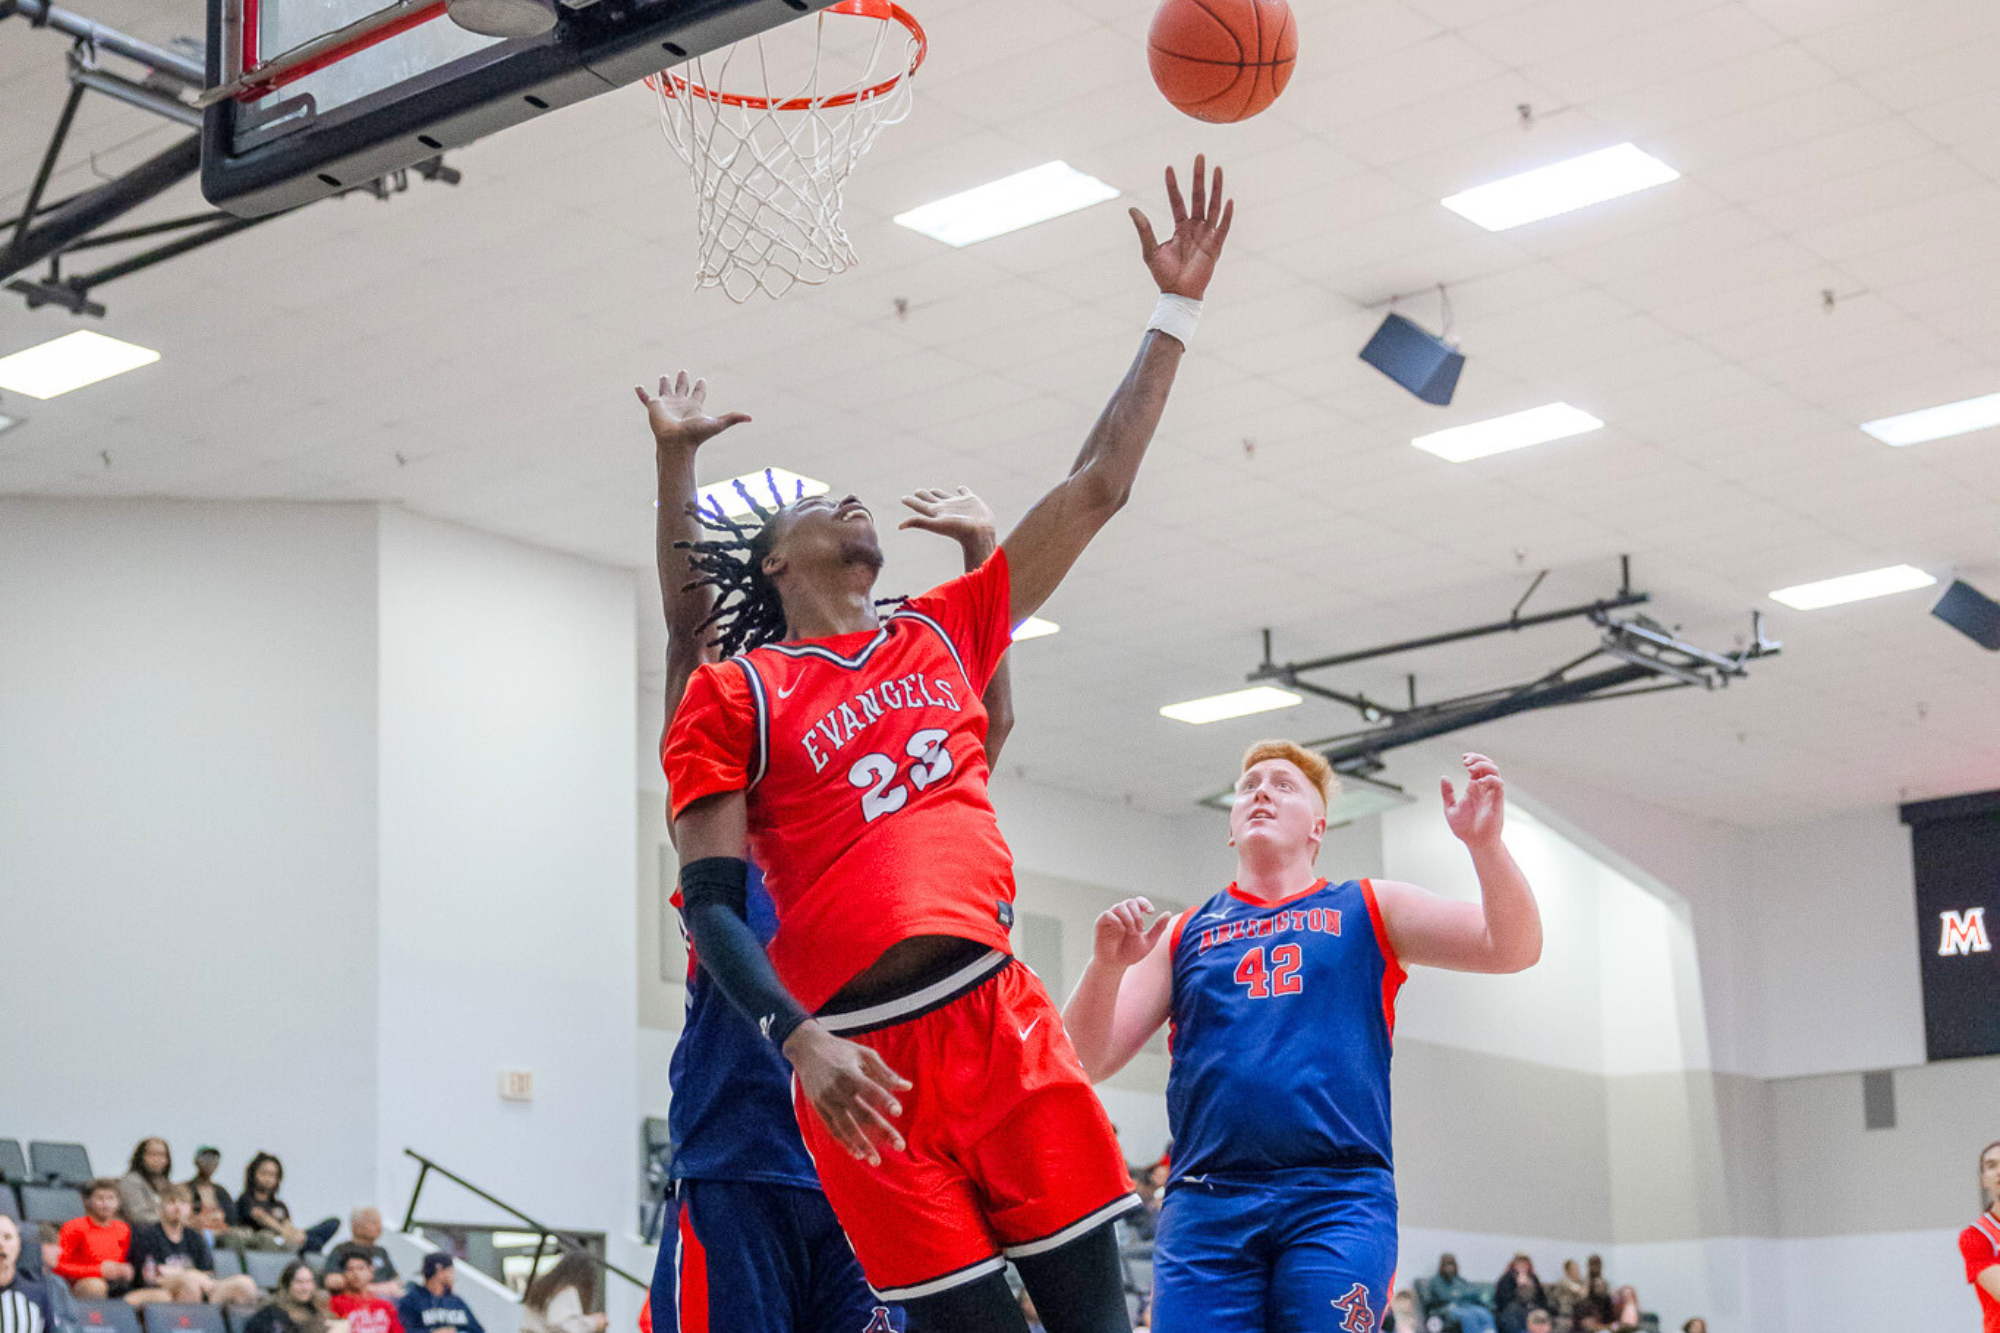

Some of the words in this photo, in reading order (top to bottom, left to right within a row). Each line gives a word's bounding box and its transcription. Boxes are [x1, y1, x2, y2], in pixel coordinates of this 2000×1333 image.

[801, 672, 962, 774] EVANGELS
[847, 728, 954, 824] 23
[1198, 907, 1342, 957] ARLINGTON
[1938, 907, 1992, 957] M
[1233, 942, 1303, 1000] 42
